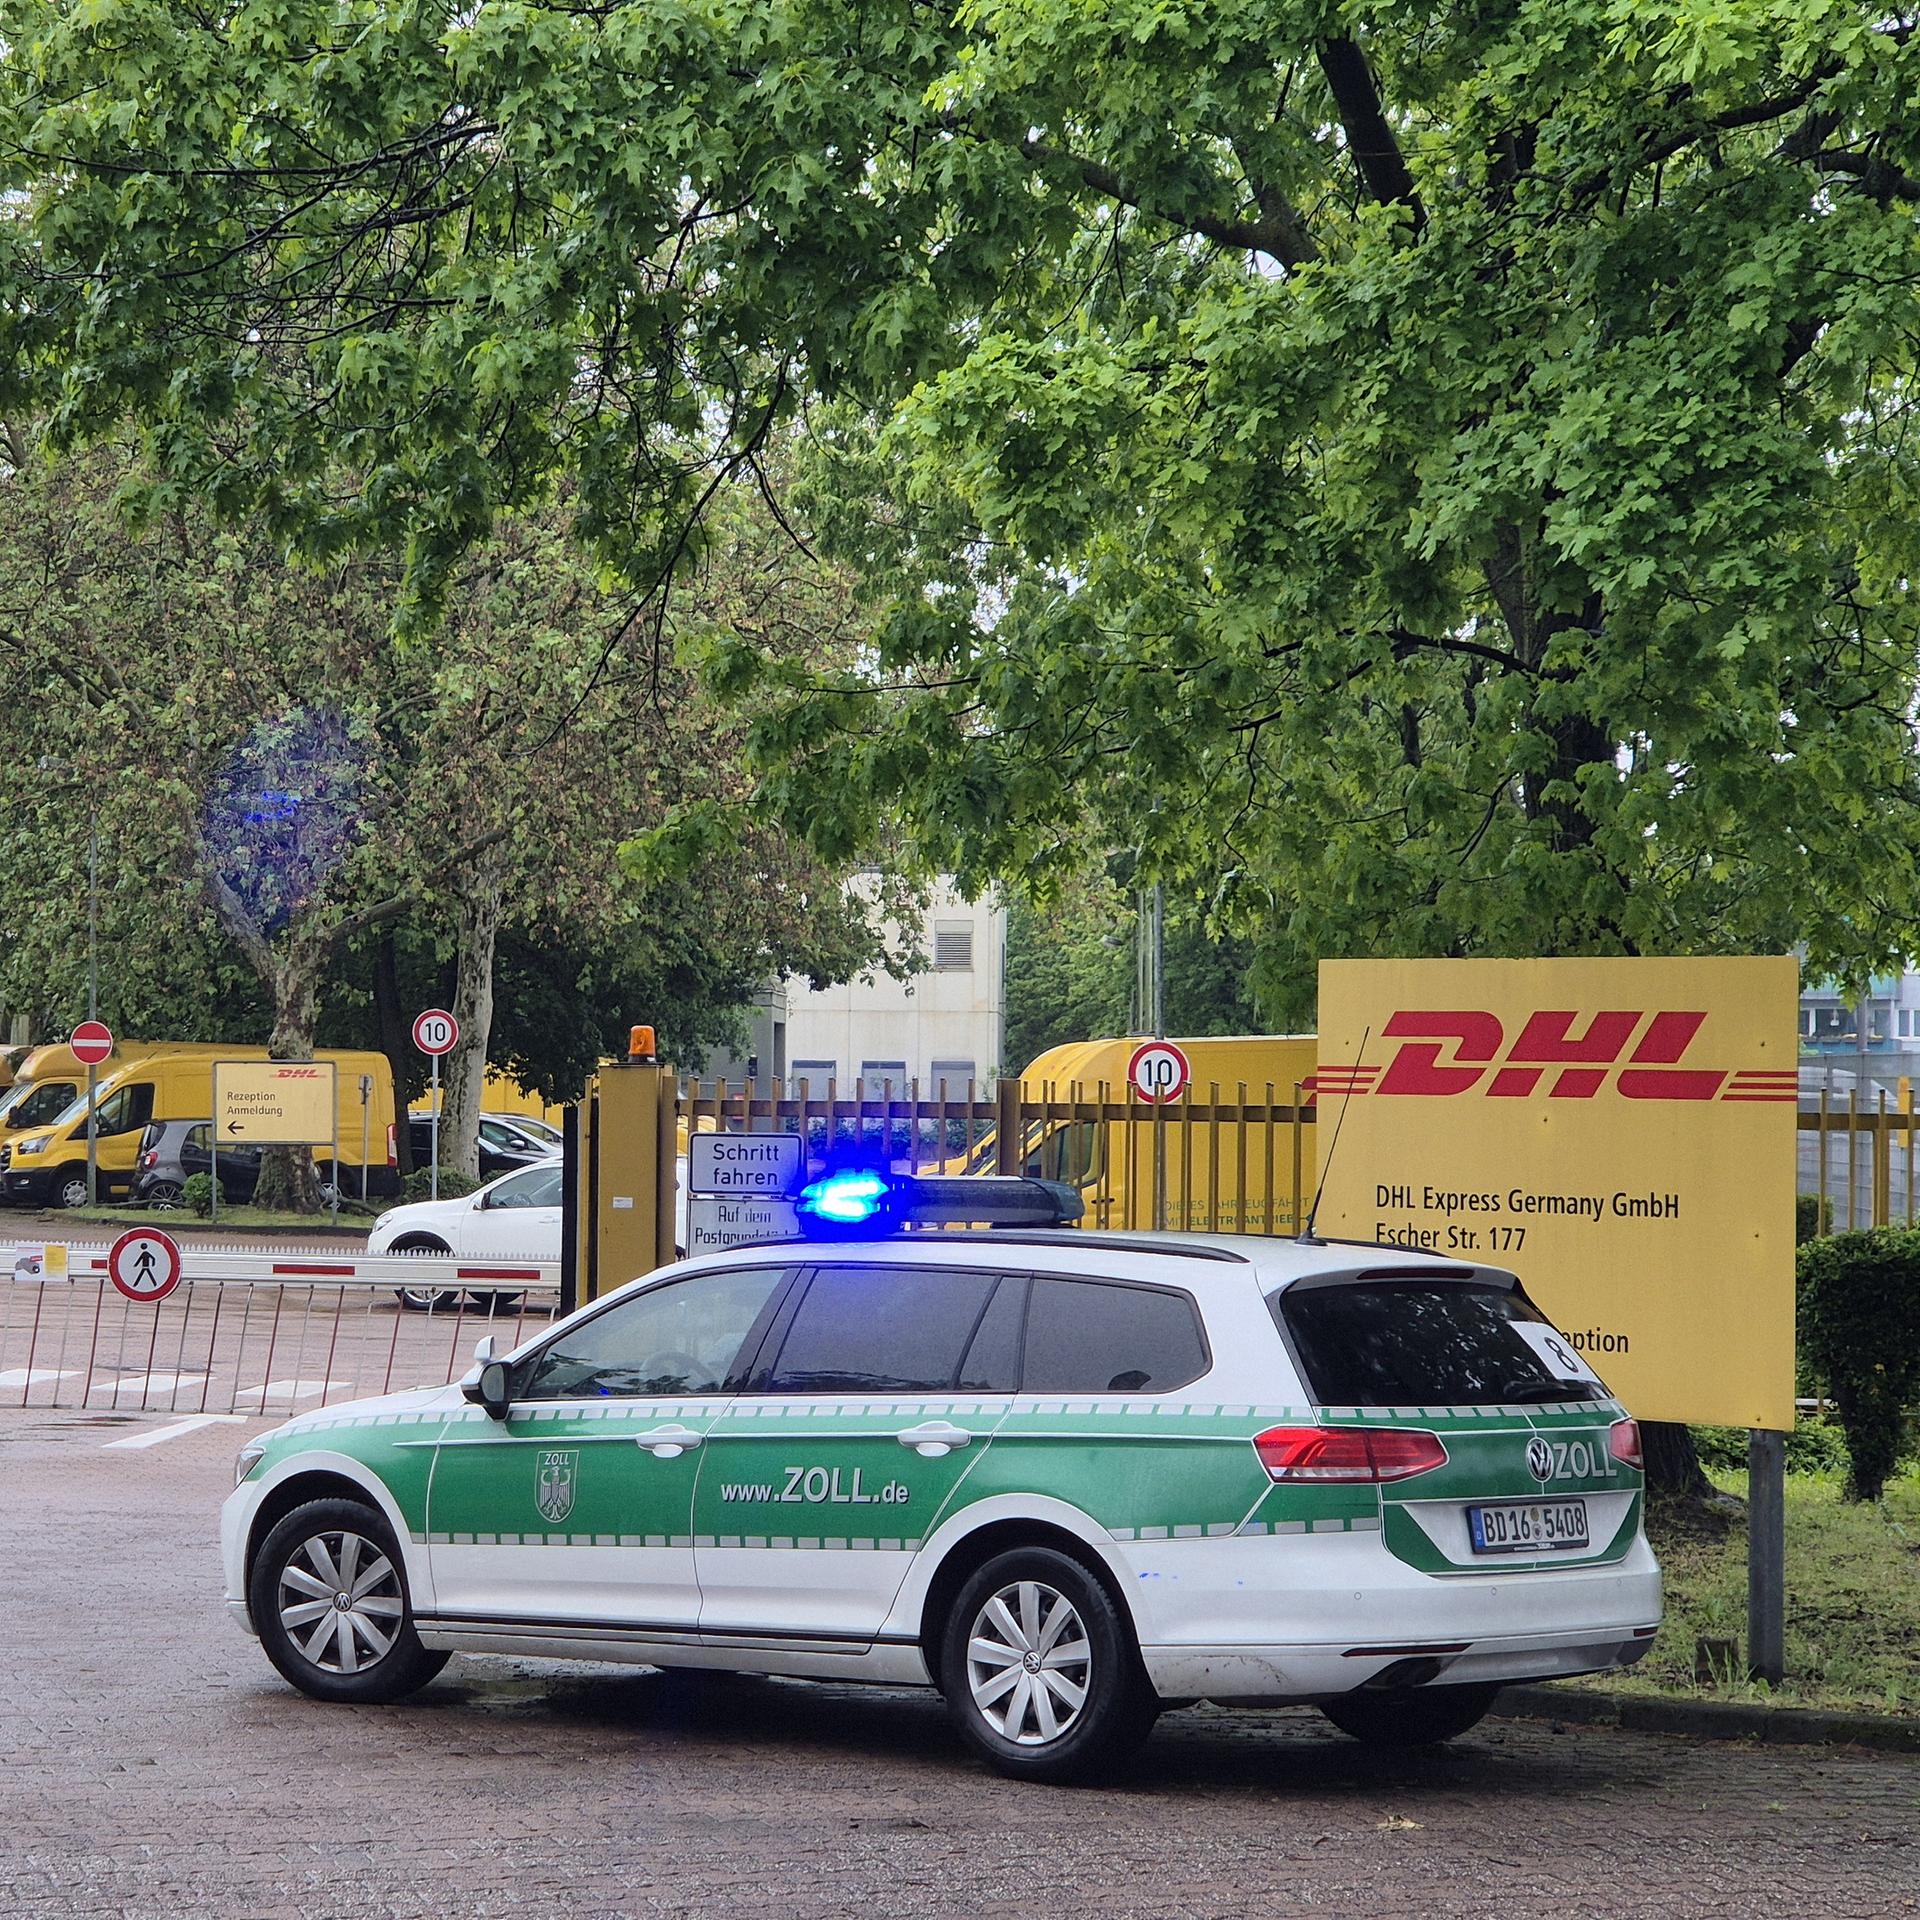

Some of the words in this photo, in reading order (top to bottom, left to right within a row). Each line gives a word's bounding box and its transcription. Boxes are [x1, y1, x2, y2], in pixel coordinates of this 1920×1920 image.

[425, 1022, 446, 1042] 10
[1375, 1010, 1729, 1100] DHL
[277, 1069, 319, 1078] DHL
[1144, 1058, 1173, 1087] 10
[227, 1091, 276, 1103] Rezeption
[227, 1105, 283, 1117] Anmeldung
[713, 1143, 780, 1161] Schritt
[713, 1167, 778, 1185] fahren
[1165, 1200, 1205, 1211] DIEES
[1376, 1184, 1416, 1209] DHL
[1423, 1186, 1501, 1217] Express
[1508, 1188, 1604, 1223] Germany
[1612, 1191, 1680, 1219] GmbH
[718, 1205, 740, 1223] Auf
[745, 1207, 771, 1223] dem
[1376, 1222, 1441, 1249] Escher
[1447, 1225, 1481, 1250] Str.
[1488, 1226, 1527, 1251] 177
[1543, 1336, 1579, 1374] 8
[544, 1453, 570, 1466] ZOLL
[1552, 1440, 1619, 1480] ZOLL
[720, 1466, 910, 1504] www.ZOLL.de
[1543, 1507, 1585, 1539] 5408
